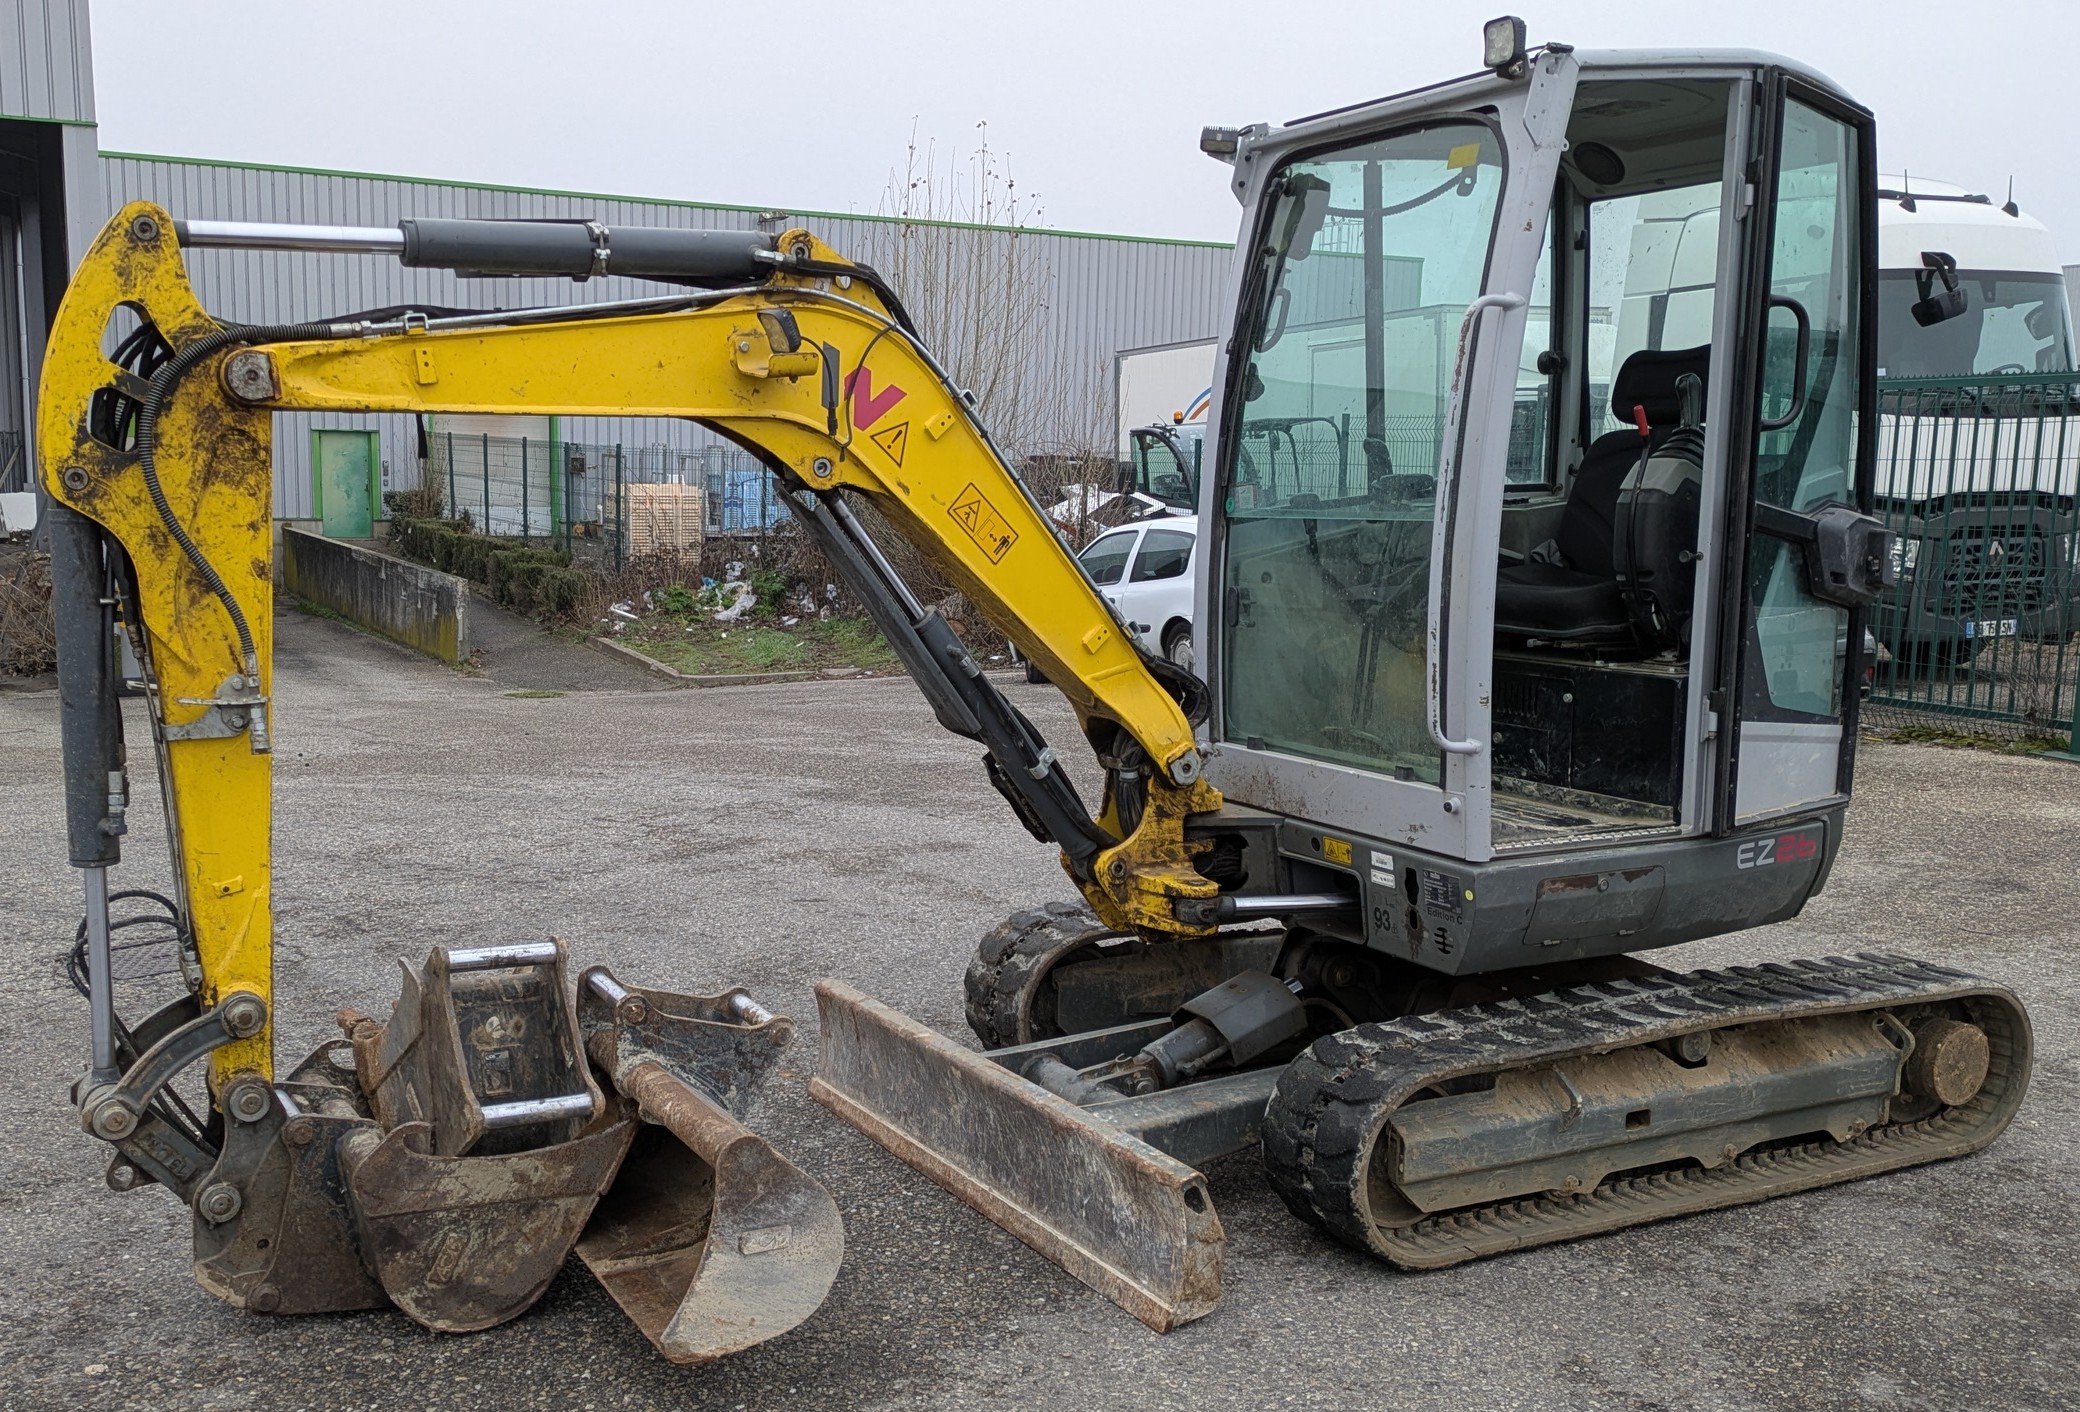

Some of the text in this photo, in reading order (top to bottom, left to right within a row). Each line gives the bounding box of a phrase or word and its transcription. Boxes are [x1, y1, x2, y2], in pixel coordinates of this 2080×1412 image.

[1737, 832, 1817, 869] EZ26
[1374, 907, 1391, 931] 93
[1427, 906, 1463, 925] Edition C
